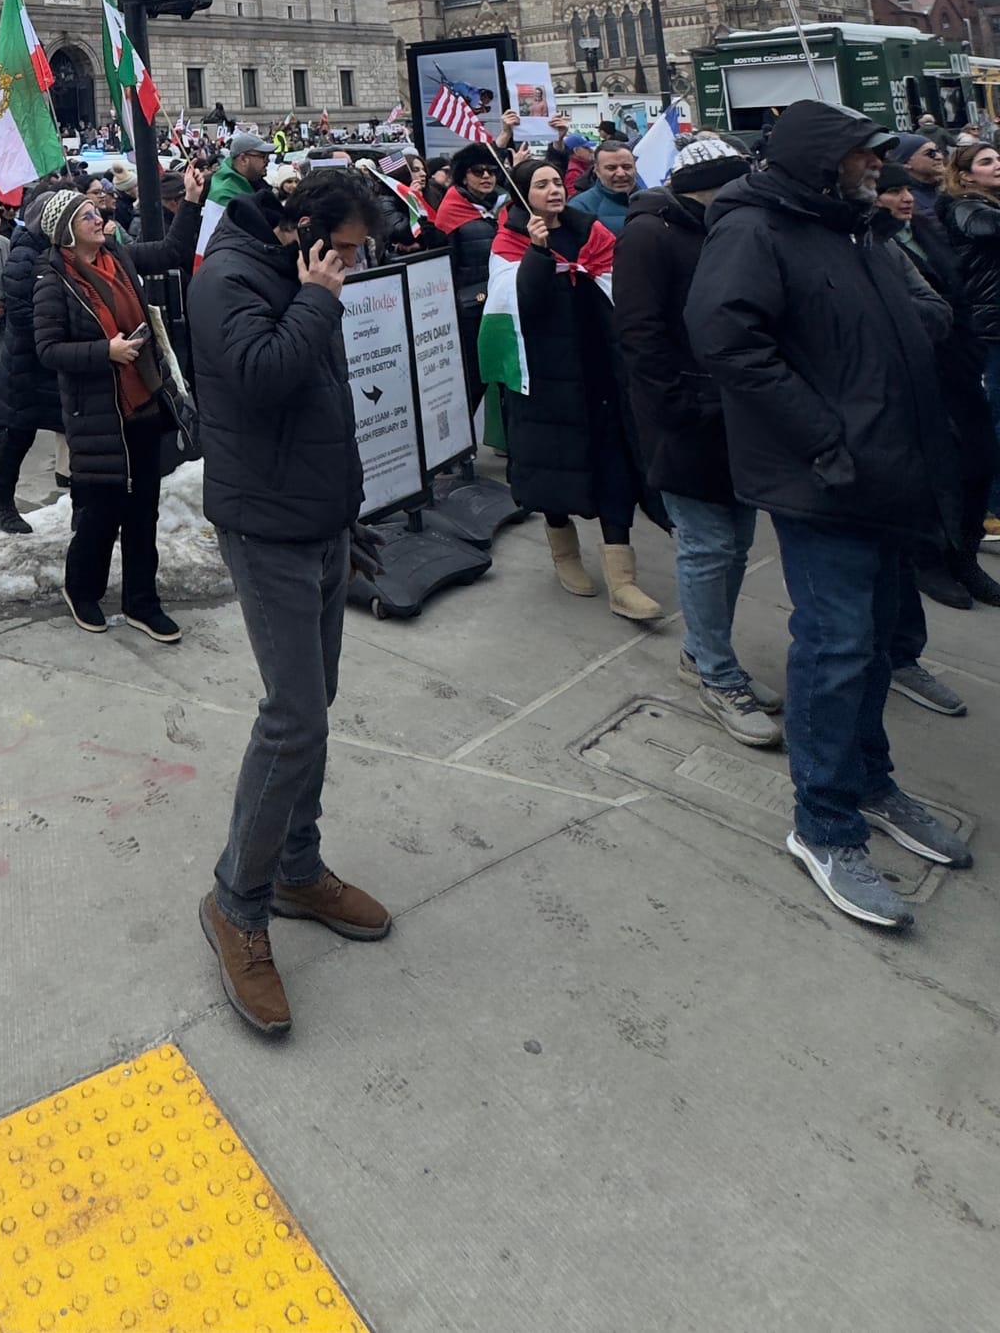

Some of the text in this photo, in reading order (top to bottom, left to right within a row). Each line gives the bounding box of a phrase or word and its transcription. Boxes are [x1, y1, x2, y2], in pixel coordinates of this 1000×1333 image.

[763, 54, 797, 62] COMMON
[799, 52, 819, 60] GLF
[415, 322, 451, 346] OPEN DAILY
[362, 352, 370, 361] TO
[371, 343, 402, 359] CELEBRATE
[349, 368, 365, 380] INTER
[372, 422, 400, 438] FEBRUARY
